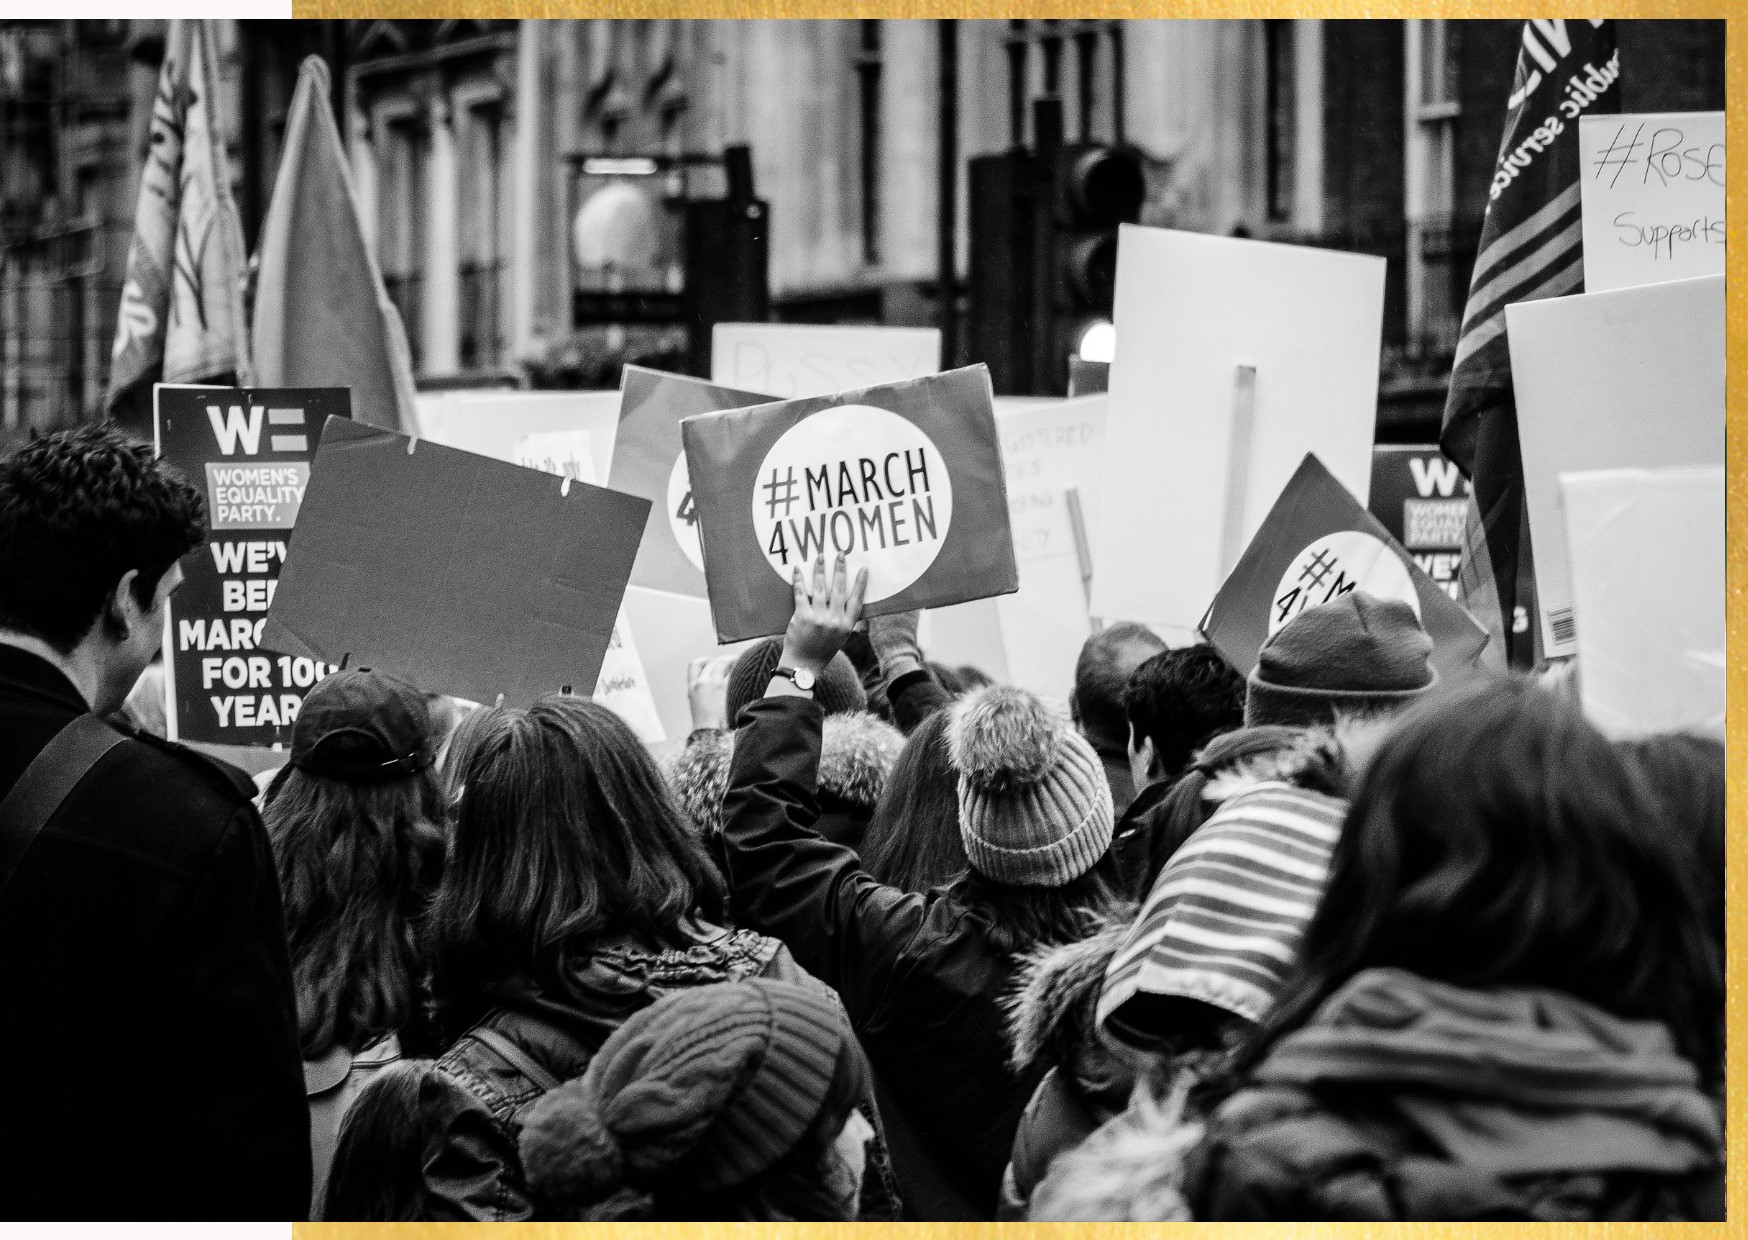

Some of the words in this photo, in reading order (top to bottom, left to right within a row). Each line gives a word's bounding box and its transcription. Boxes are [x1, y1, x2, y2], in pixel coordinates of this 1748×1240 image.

[213, 468, 299, 486] WOMEN'S
[762, 447, 931, 519] #MARCH
[215, 486, 304, 504] EQUALITY
[217, 504, 281, 522] PARTY.
[768, 495, 938, 566] 4WOMEN
[202, 656, 272, 689] FOR
